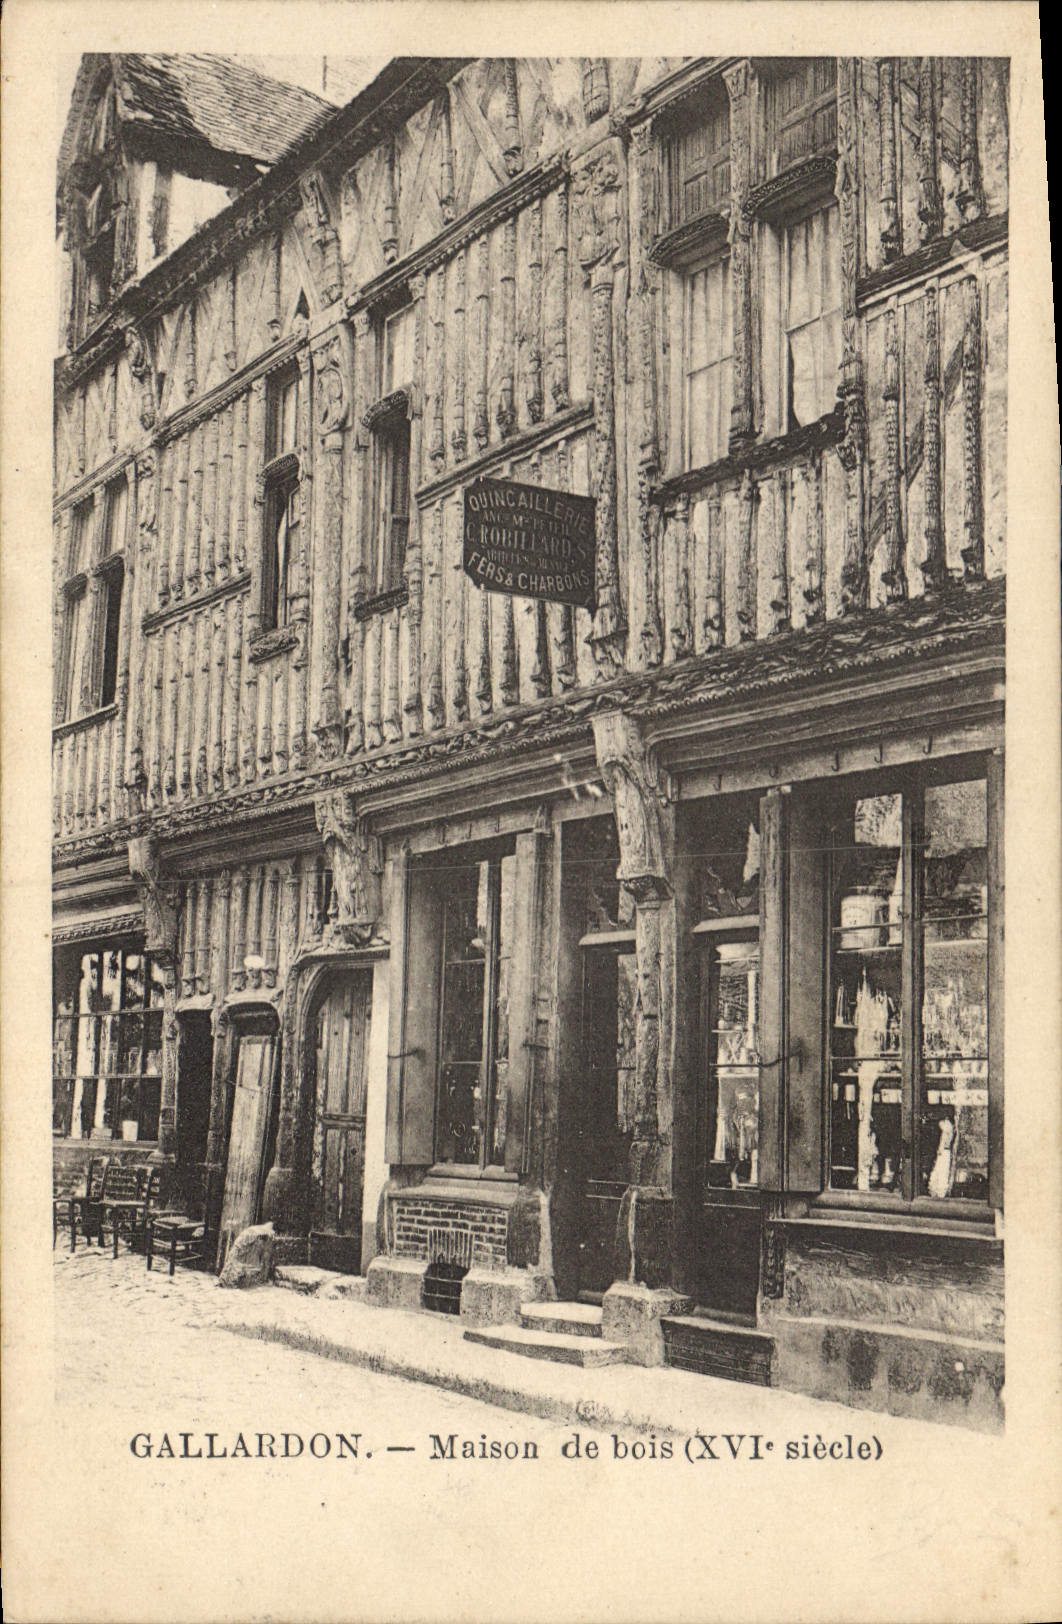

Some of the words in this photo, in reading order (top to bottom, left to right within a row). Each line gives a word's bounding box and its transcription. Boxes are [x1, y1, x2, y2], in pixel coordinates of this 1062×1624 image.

[469, 490, 587, 534] QUINCAILLERIE
[468, 551, 505, 583] FERS
[505, 573, 513, 586] &
[518, 569, 590, 593] CHARBONS
